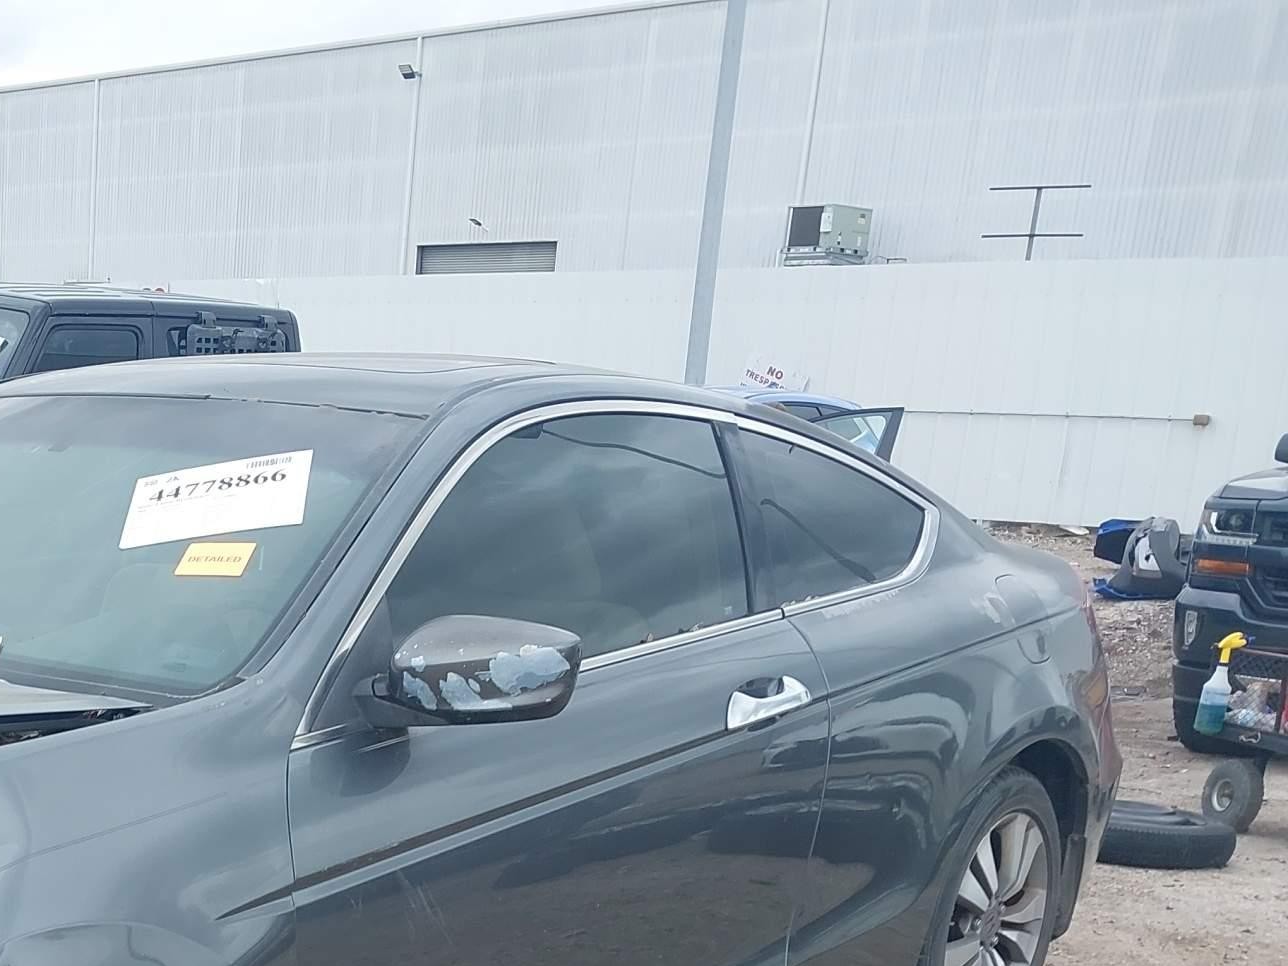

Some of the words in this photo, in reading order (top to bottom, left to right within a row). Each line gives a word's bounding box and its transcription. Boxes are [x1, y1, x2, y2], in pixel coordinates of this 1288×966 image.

[767, 366, 784, 380] NO
[149, 468, 287, 502] 44778866
[187, 555, 243, 564] DETAILED
